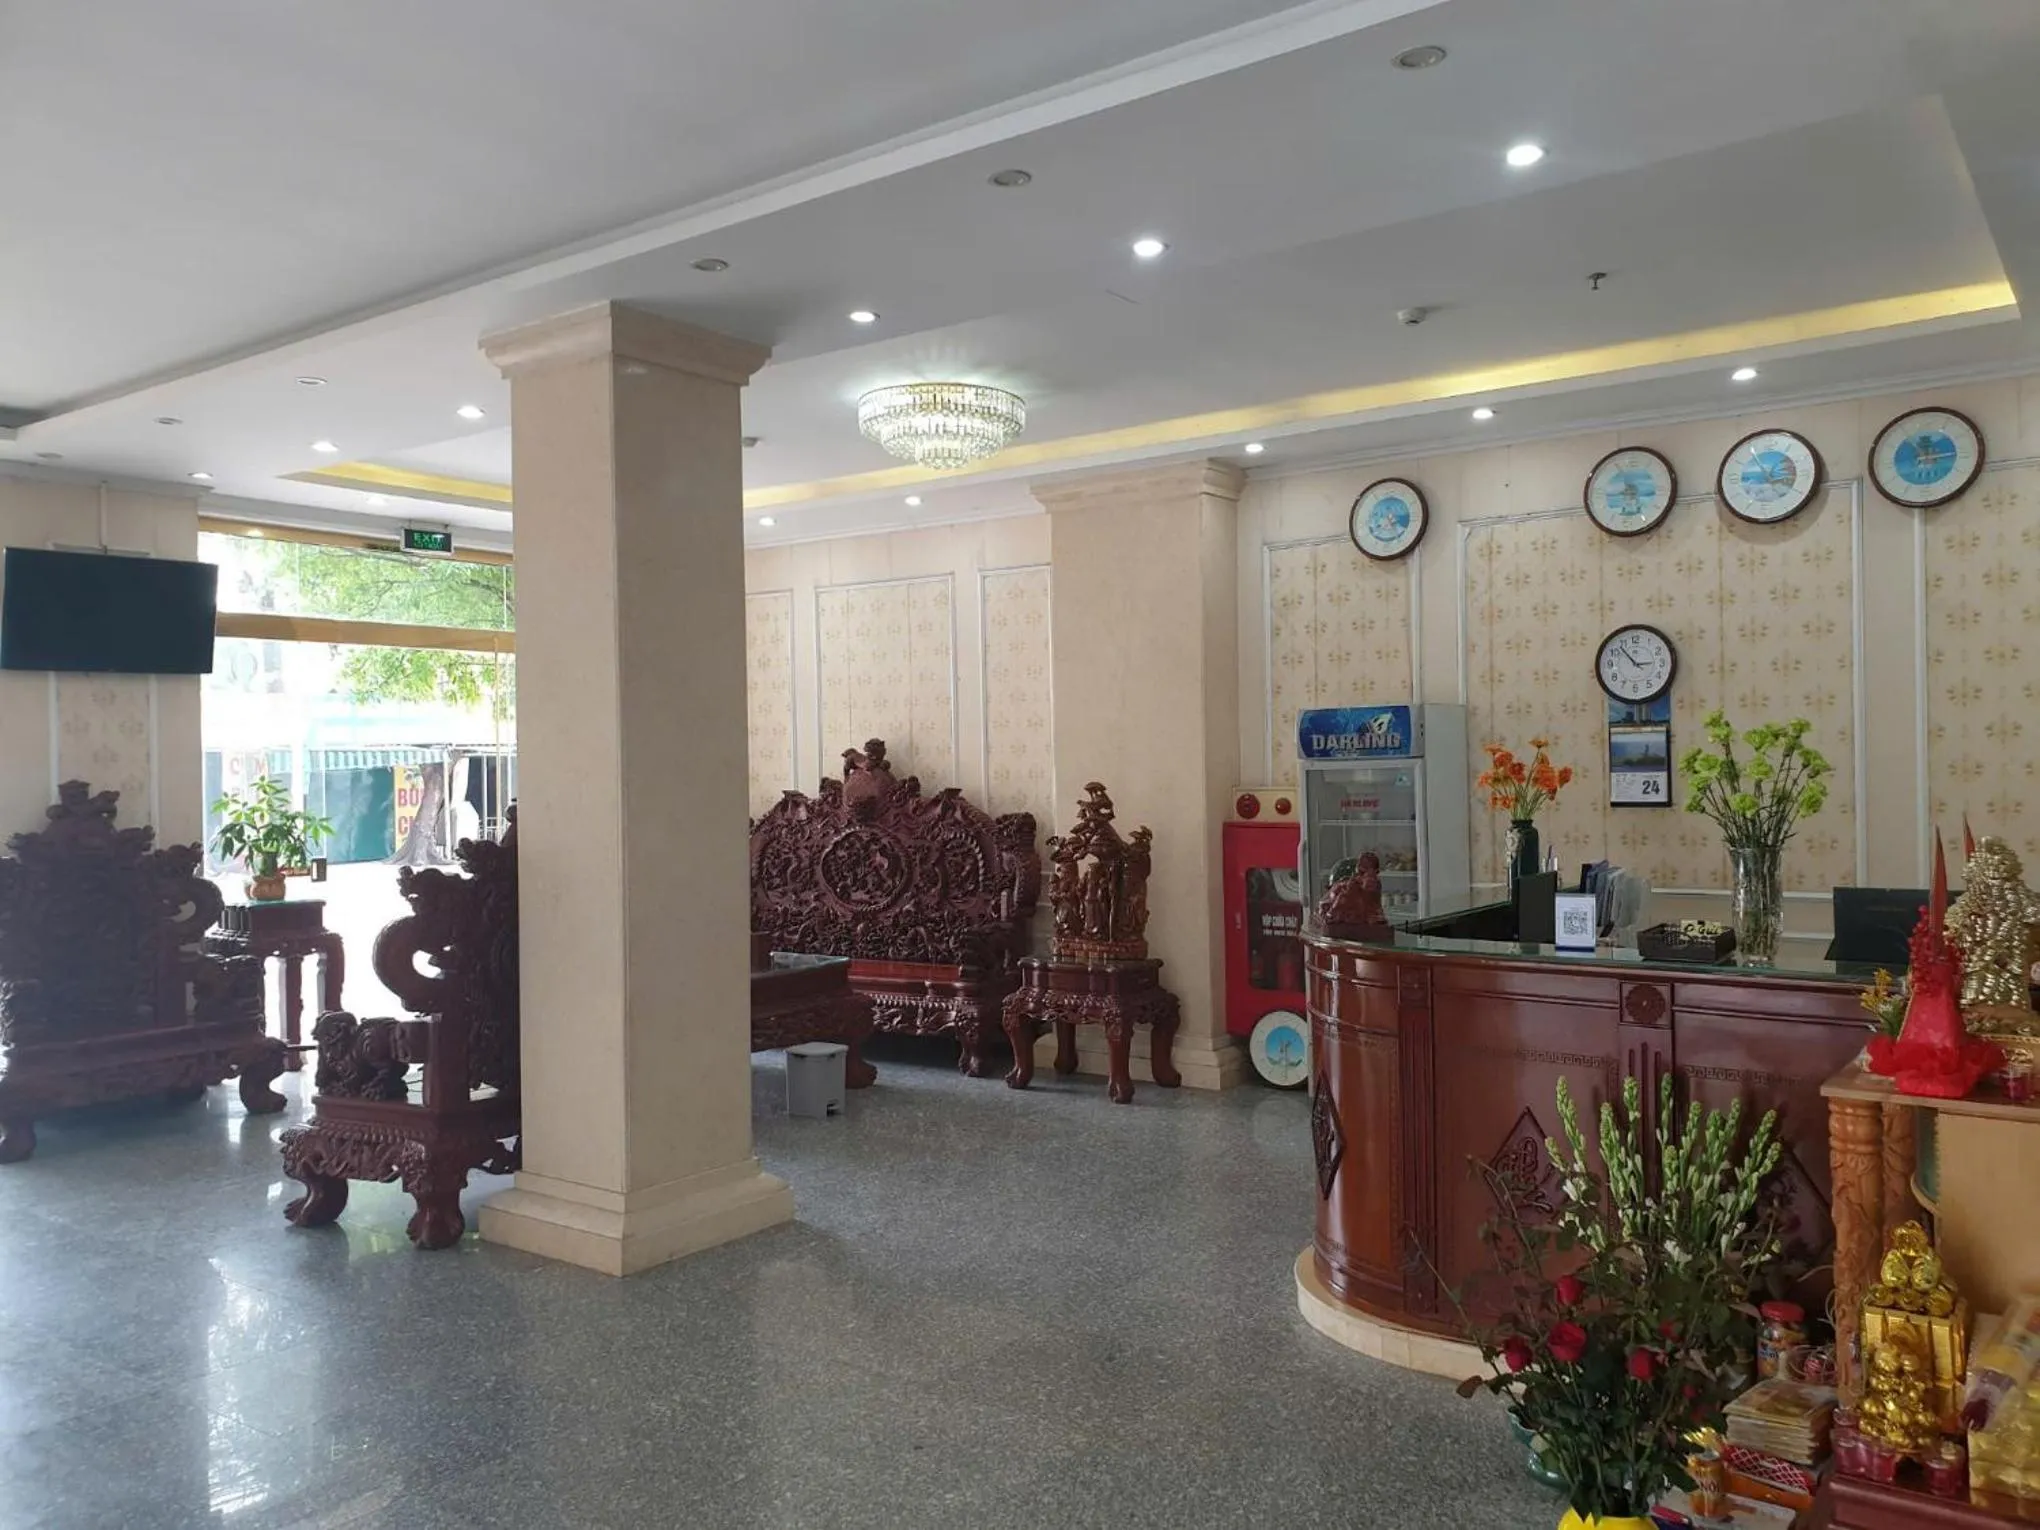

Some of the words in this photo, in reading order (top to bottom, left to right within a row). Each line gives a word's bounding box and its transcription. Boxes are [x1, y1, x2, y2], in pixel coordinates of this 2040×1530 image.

[1632, 636, 1640, 644] 12
[1607, 659, 1613, 669] 9
[1659, 658, 1665, 668] 3
[1611, 672, 1617, 682] 8
[1632, 684, 1639, 693] 6
[1311, 733, 1401, 750] DARLING
[1642, 780, 1660, 795] 24
